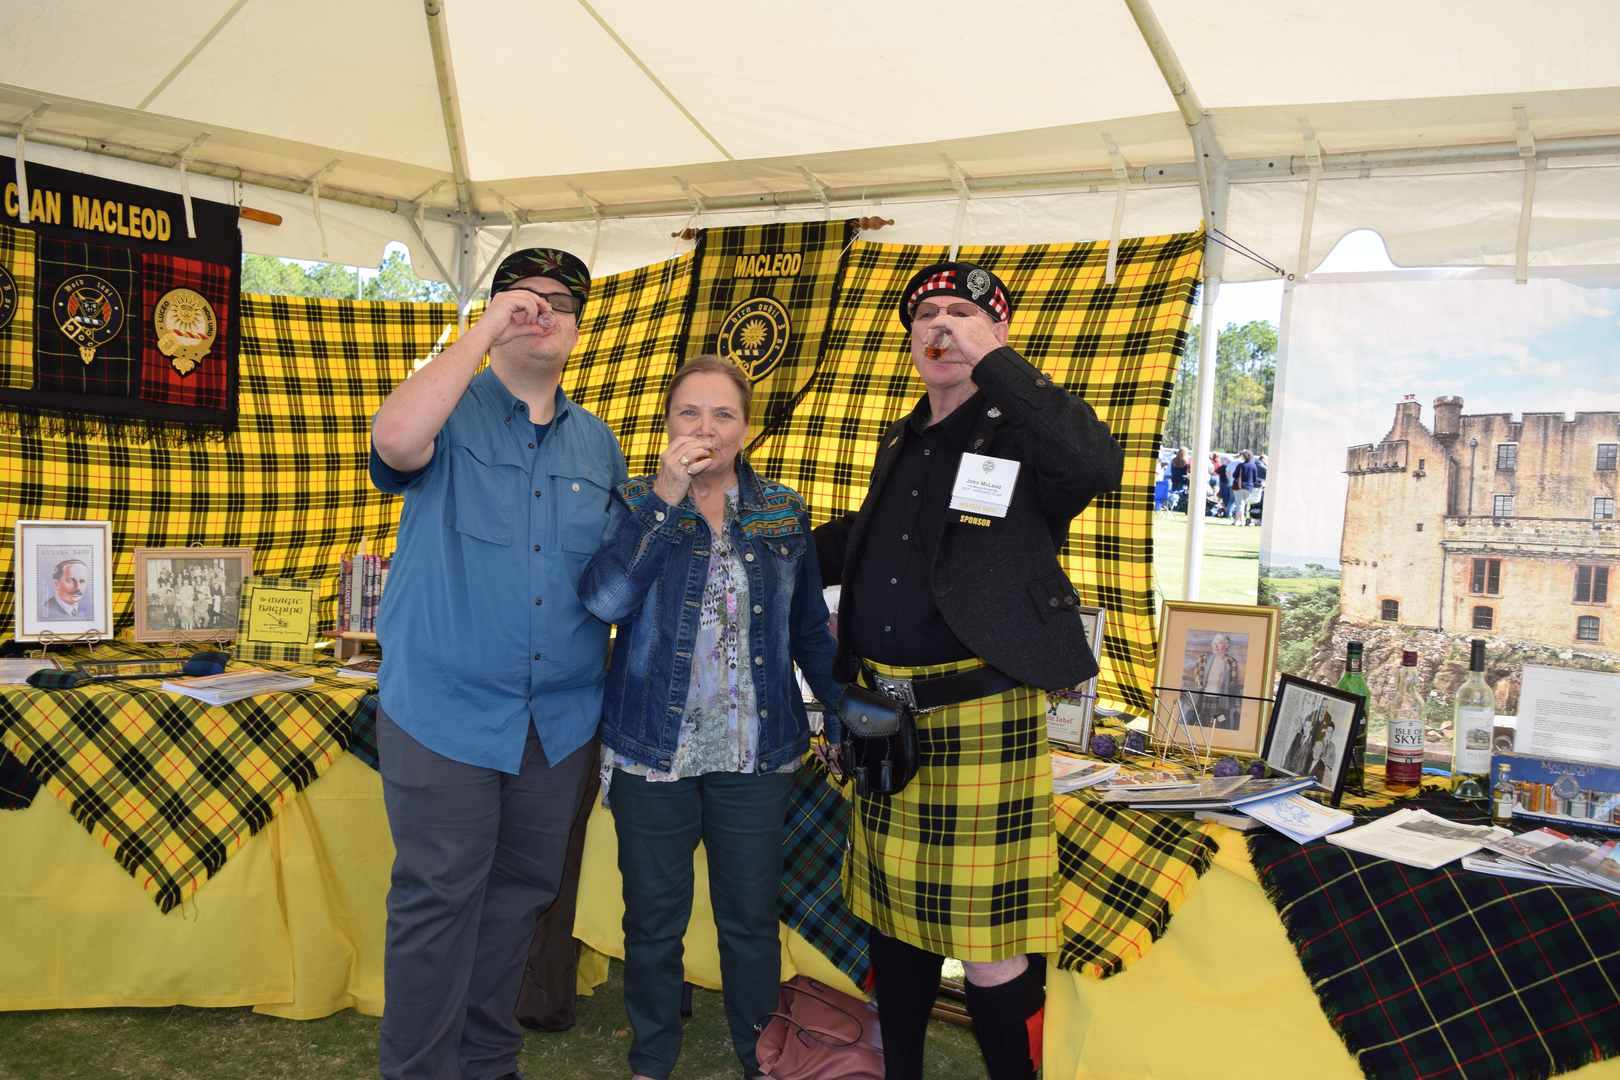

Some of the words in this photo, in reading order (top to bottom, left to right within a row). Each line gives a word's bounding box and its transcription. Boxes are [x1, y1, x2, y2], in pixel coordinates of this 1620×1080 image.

[4, 182, 61, 225] CAN
[72, 195, 171, 241] MACLEOD
[733, 253, 802, 278] MACLEOD
[158, 300, 170, 323] LUCEO
[202, 306, 213, 321] NON
[980, 481, 1002, 490] McLeod
[959, 501, 982, 511] HONORED
[982, 505, 998, 513] GUEST
[960, 515, 991, 527] SPONSOR
[1395, 727, 1412, 736] ISLE
[1413, 728, 1422, 736] OF
[1394, 734, 1422, 745] SKYE
[1541, 761, 1596, 775] MACLEOD'S
